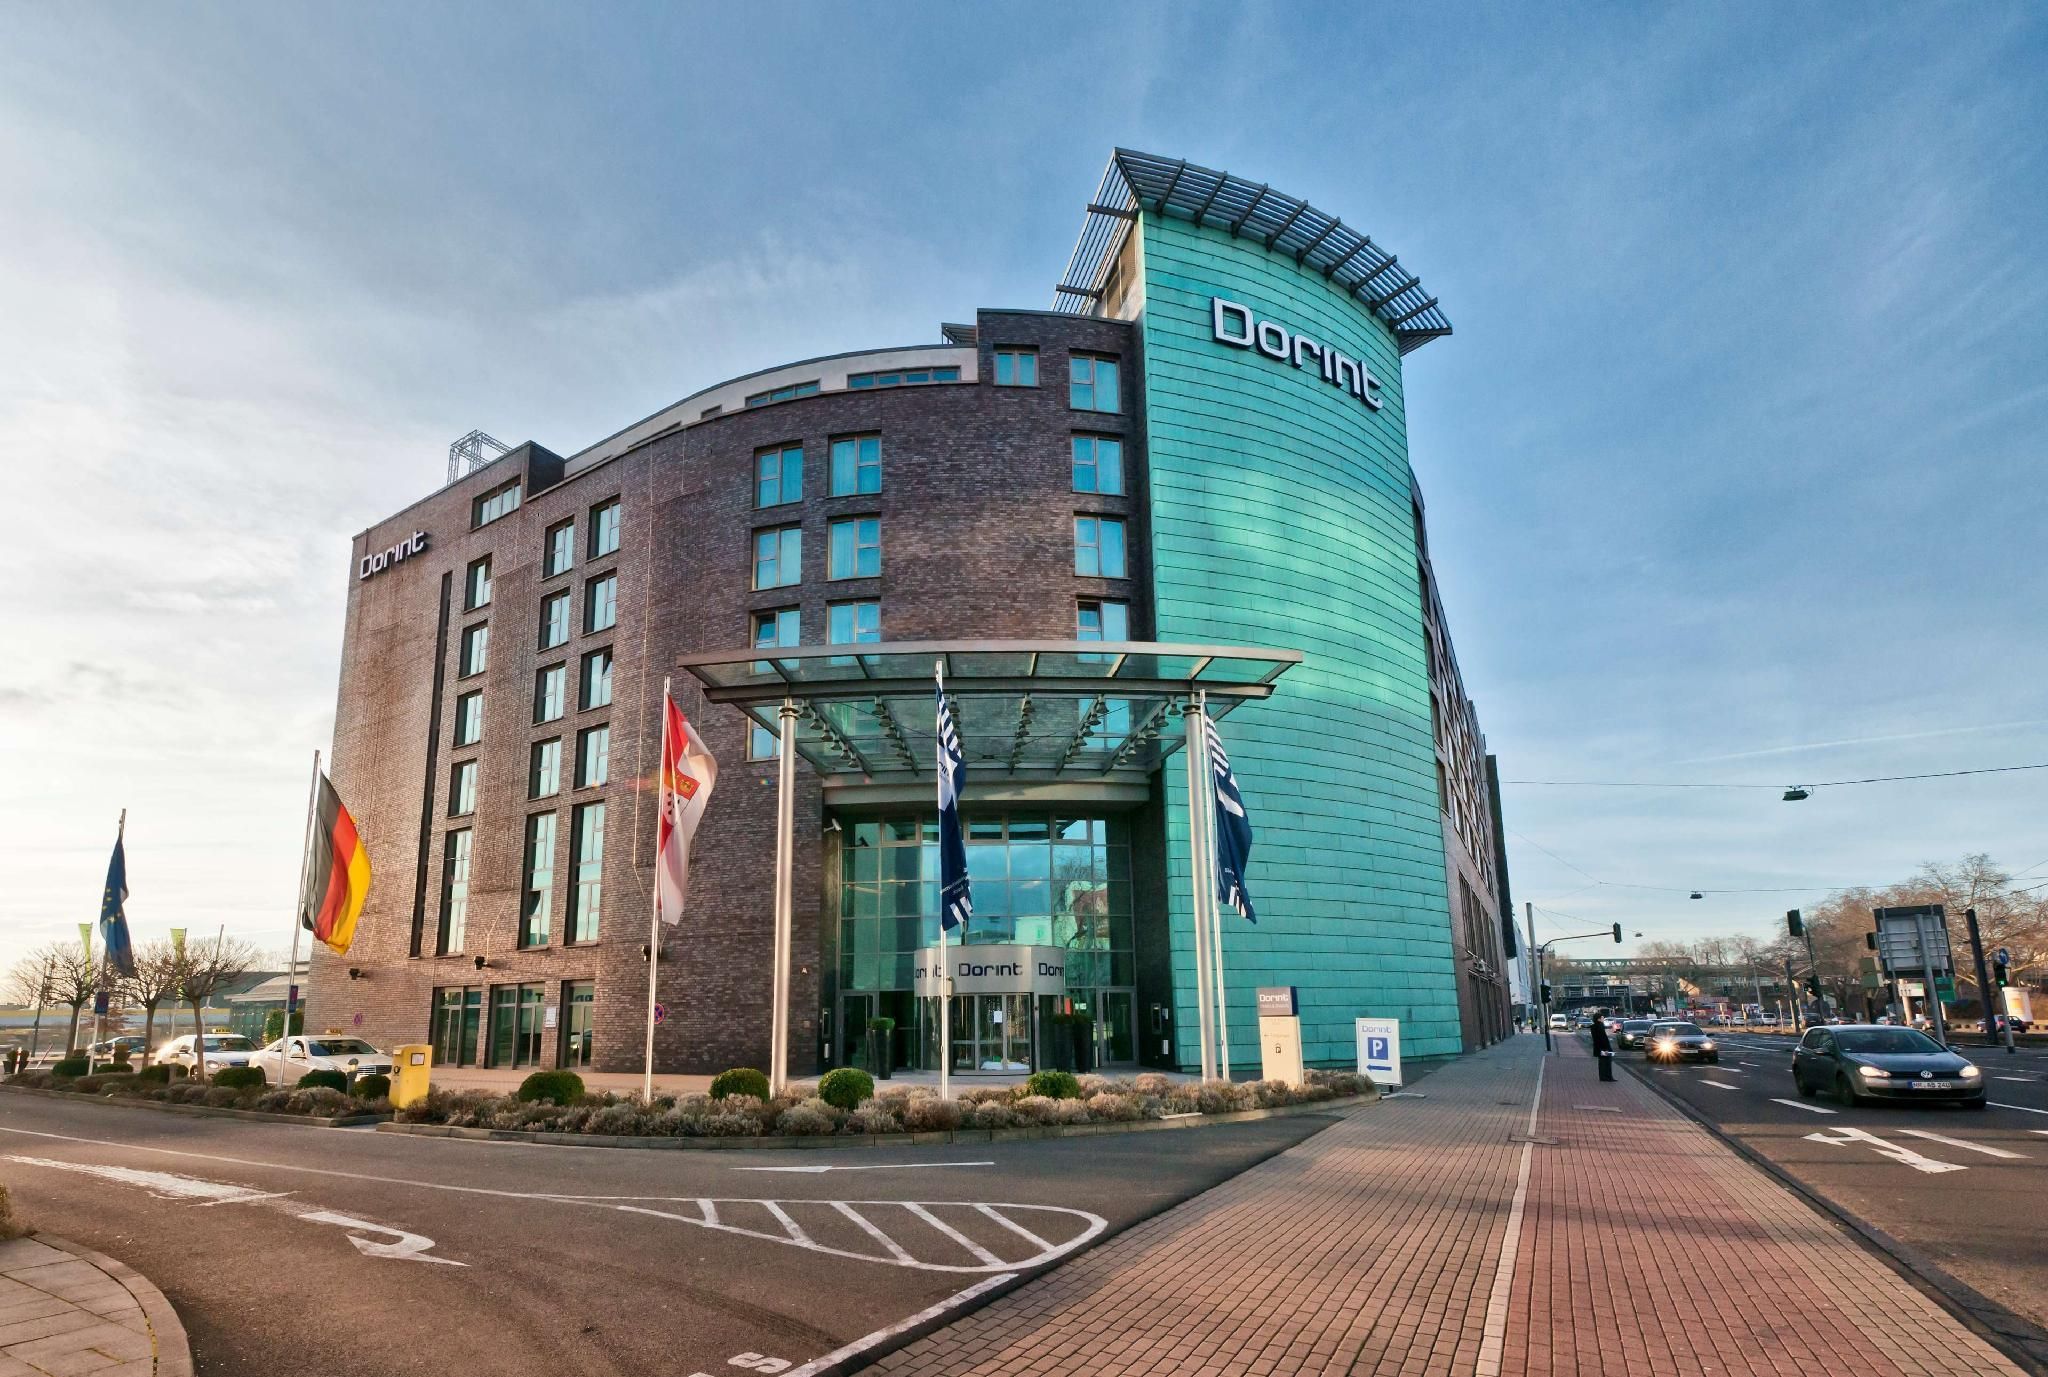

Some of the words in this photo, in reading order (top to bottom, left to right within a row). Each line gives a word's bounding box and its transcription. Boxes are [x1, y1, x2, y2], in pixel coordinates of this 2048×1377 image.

[1213, 296, 1383, 411] Dorint
[360, 531, 426, 580] Dorint
[958, 962, 1023, 977] Dorint
[1362, 1025, 1391, 1033] Dorint
[1373, 1040, 1383, 1056] P
